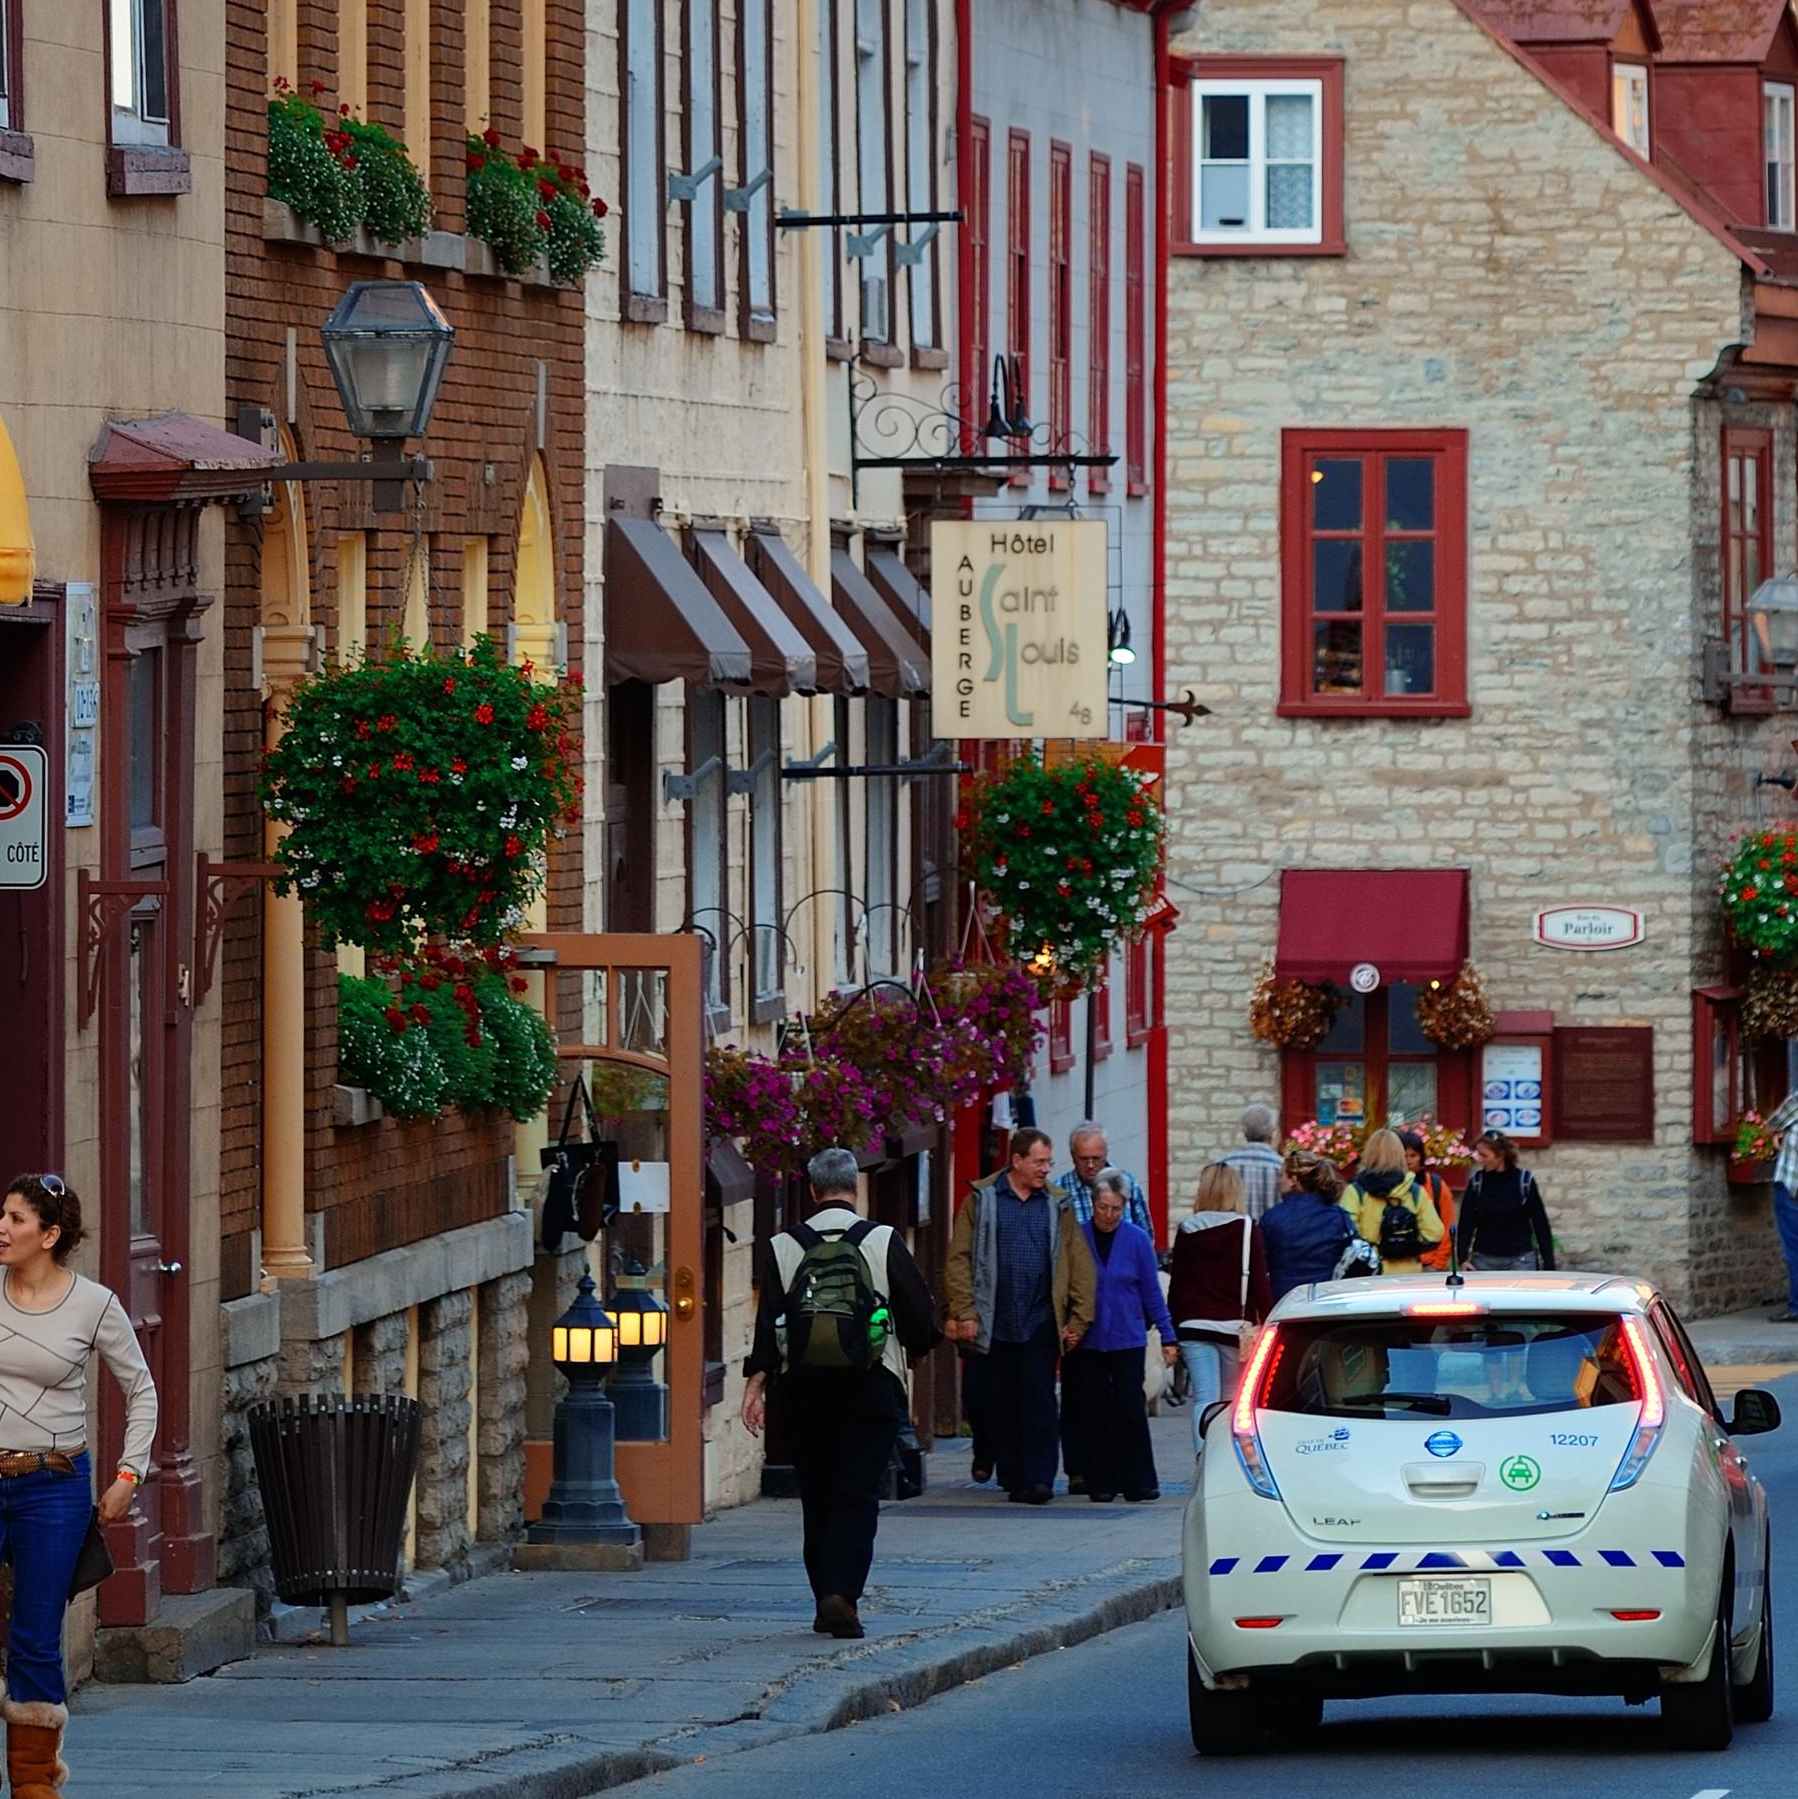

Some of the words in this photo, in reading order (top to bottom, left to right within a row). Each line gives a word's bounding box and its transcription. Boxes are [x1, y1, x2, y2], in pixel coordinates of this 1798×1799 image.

[991, 533, 1055, 554] Hôtel
[979, 563, 1059, 682] Saint
[956, 555, 974, 718] AUBERGE
[1005, 623, 1080, 726] Louis
[1069, 702, 1092, 726] 48
[7, 842, 39, 862] CÔTÉ
[1564, 922, 1614, 935] Parloir
[1551, 1434, 1599, 1447] 12207
